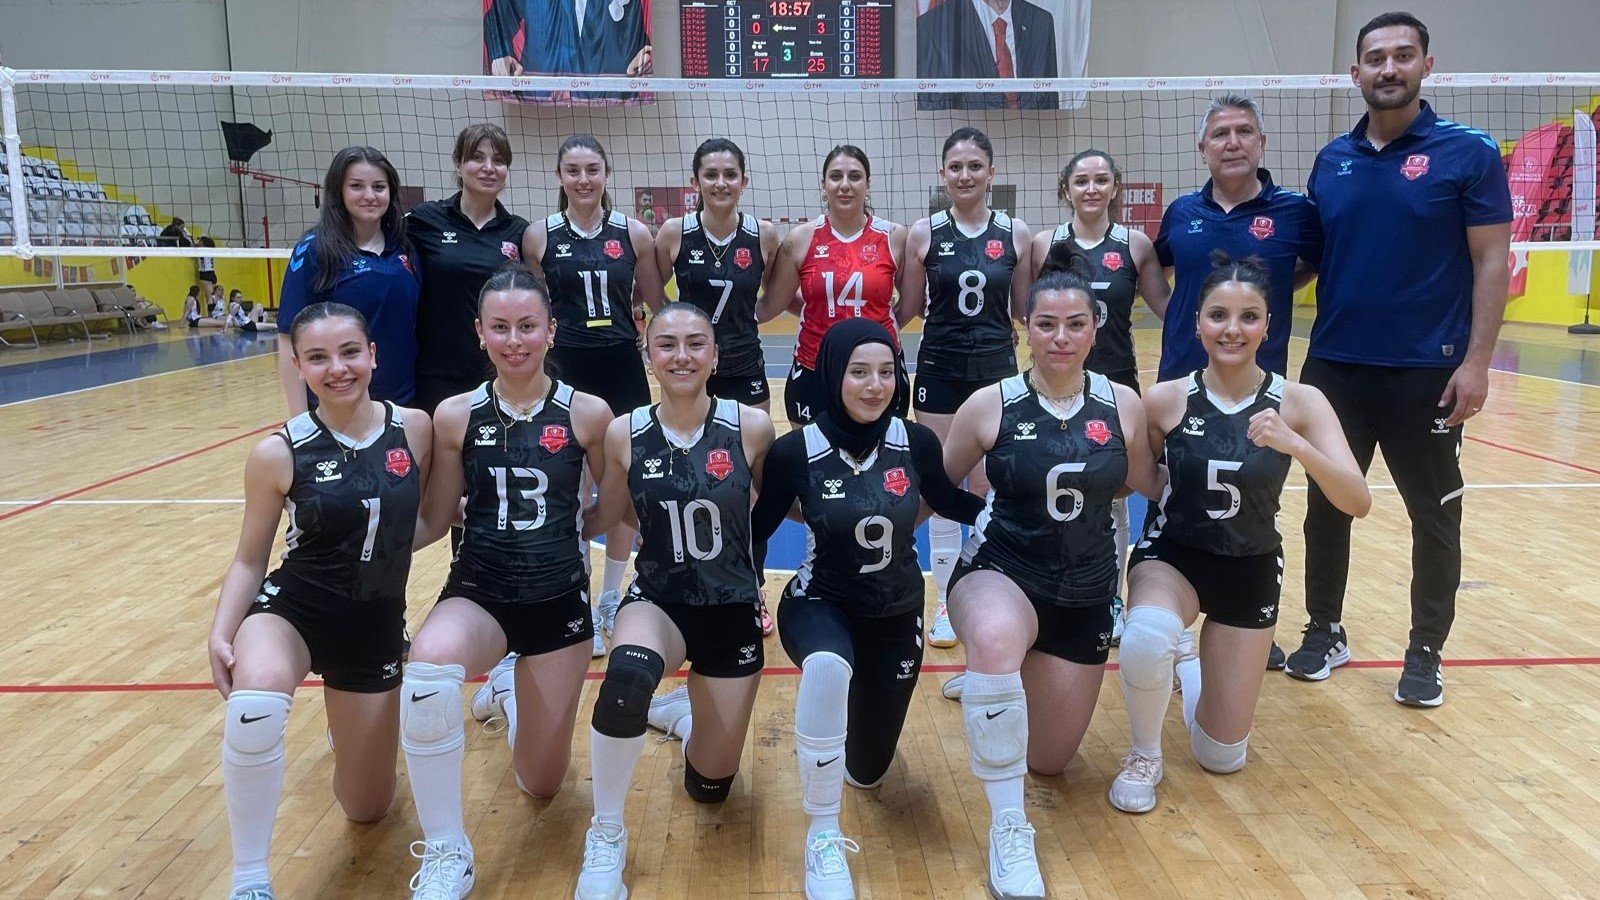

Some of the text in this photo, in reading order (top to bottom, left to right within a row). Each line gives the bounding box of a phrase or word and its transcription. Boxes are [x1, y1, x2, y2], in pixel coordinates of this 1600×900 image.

[752, 22, 760, 34] 0
[770, 2, 811, 16] 18:57
[817, 22, 825, 34] 3
[753, 58, 769, 72] 17
[784, 49, 792, 61] 3
[808, 58, 825, 72] 25
[578, 270, 611, 317] 11
[708, 279, 733, 324] 7
[822, 271, 867, 317] 14
[958, 270, 986, 317] 8
[796, 402, 812, 421] 14
[918, 387, 926, 402] 8
[488, 467, 548, 530] 13
[1046, 463, 1086, 522] 6
[1206, 460, 1243, 519] 5
[361, 498, 380, 561] 1
[659, 499, 722, 562] 10
[855, 515, 894, 574] 9
